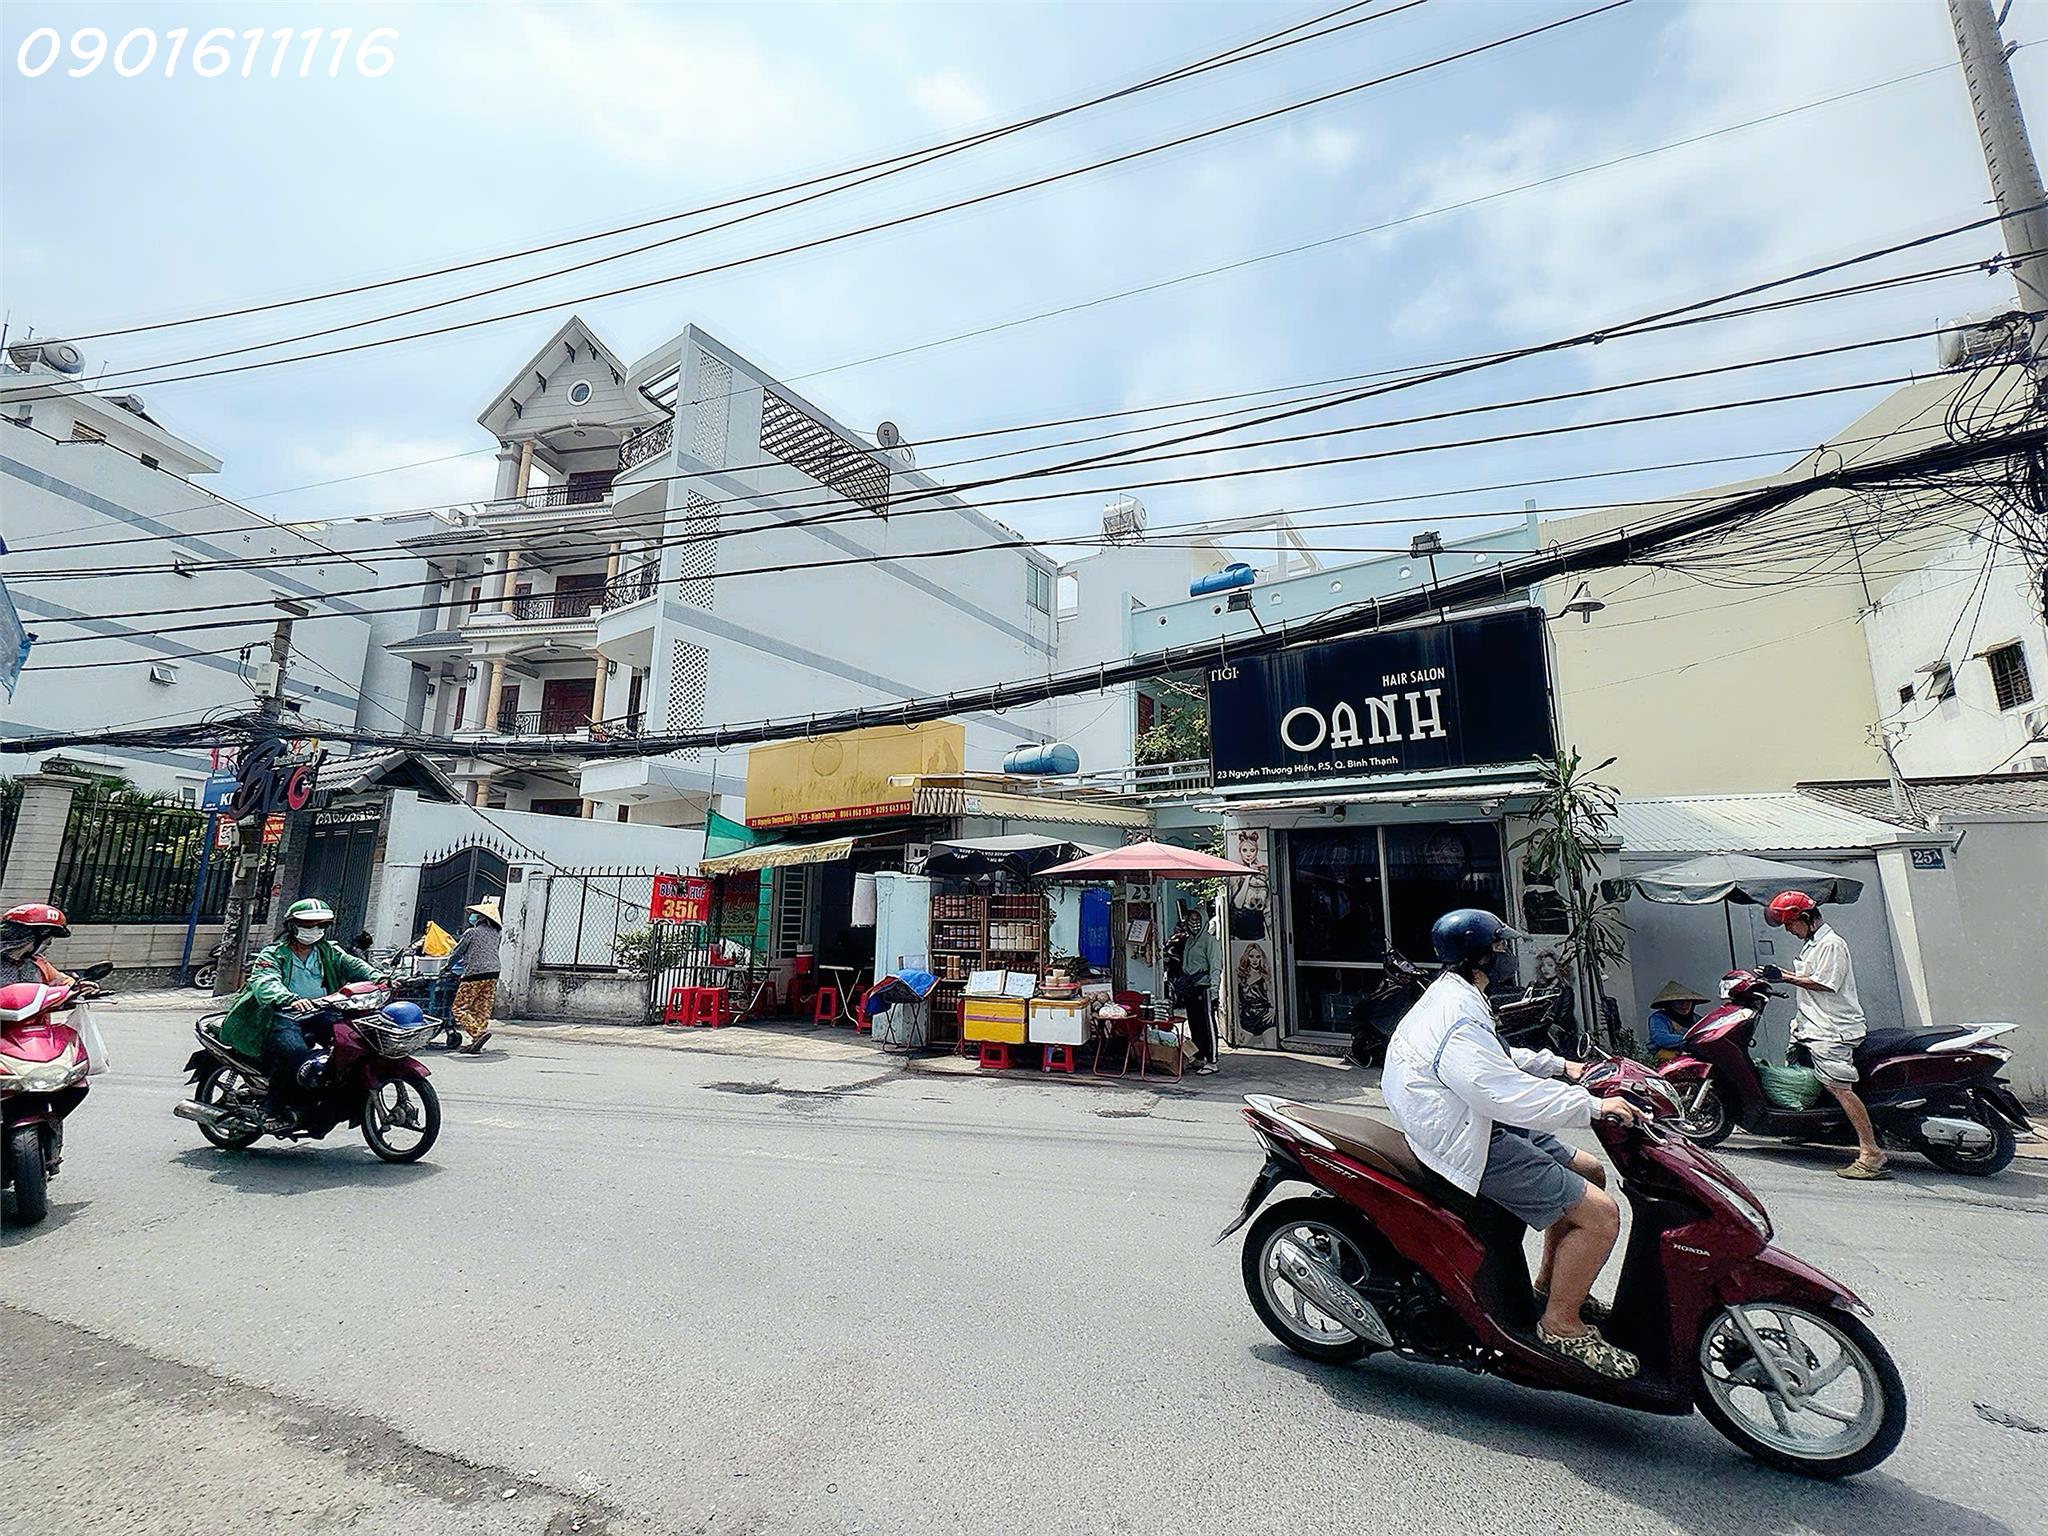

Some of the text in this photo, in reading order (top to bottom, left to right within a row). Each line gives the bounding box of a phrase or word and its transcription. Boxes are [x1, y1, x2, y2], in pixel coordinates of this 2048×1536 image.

[1382, 667, 1446, 687] HAIR SALON
[1280, 688, 1447, 752] OANH
[1217, 771, 1227, 779] 23
[1334, 760, 1346, 769] Q.
[1132, 886, 1150, 900] 23
[1673, 1242, 1711, 1257] HONDA
